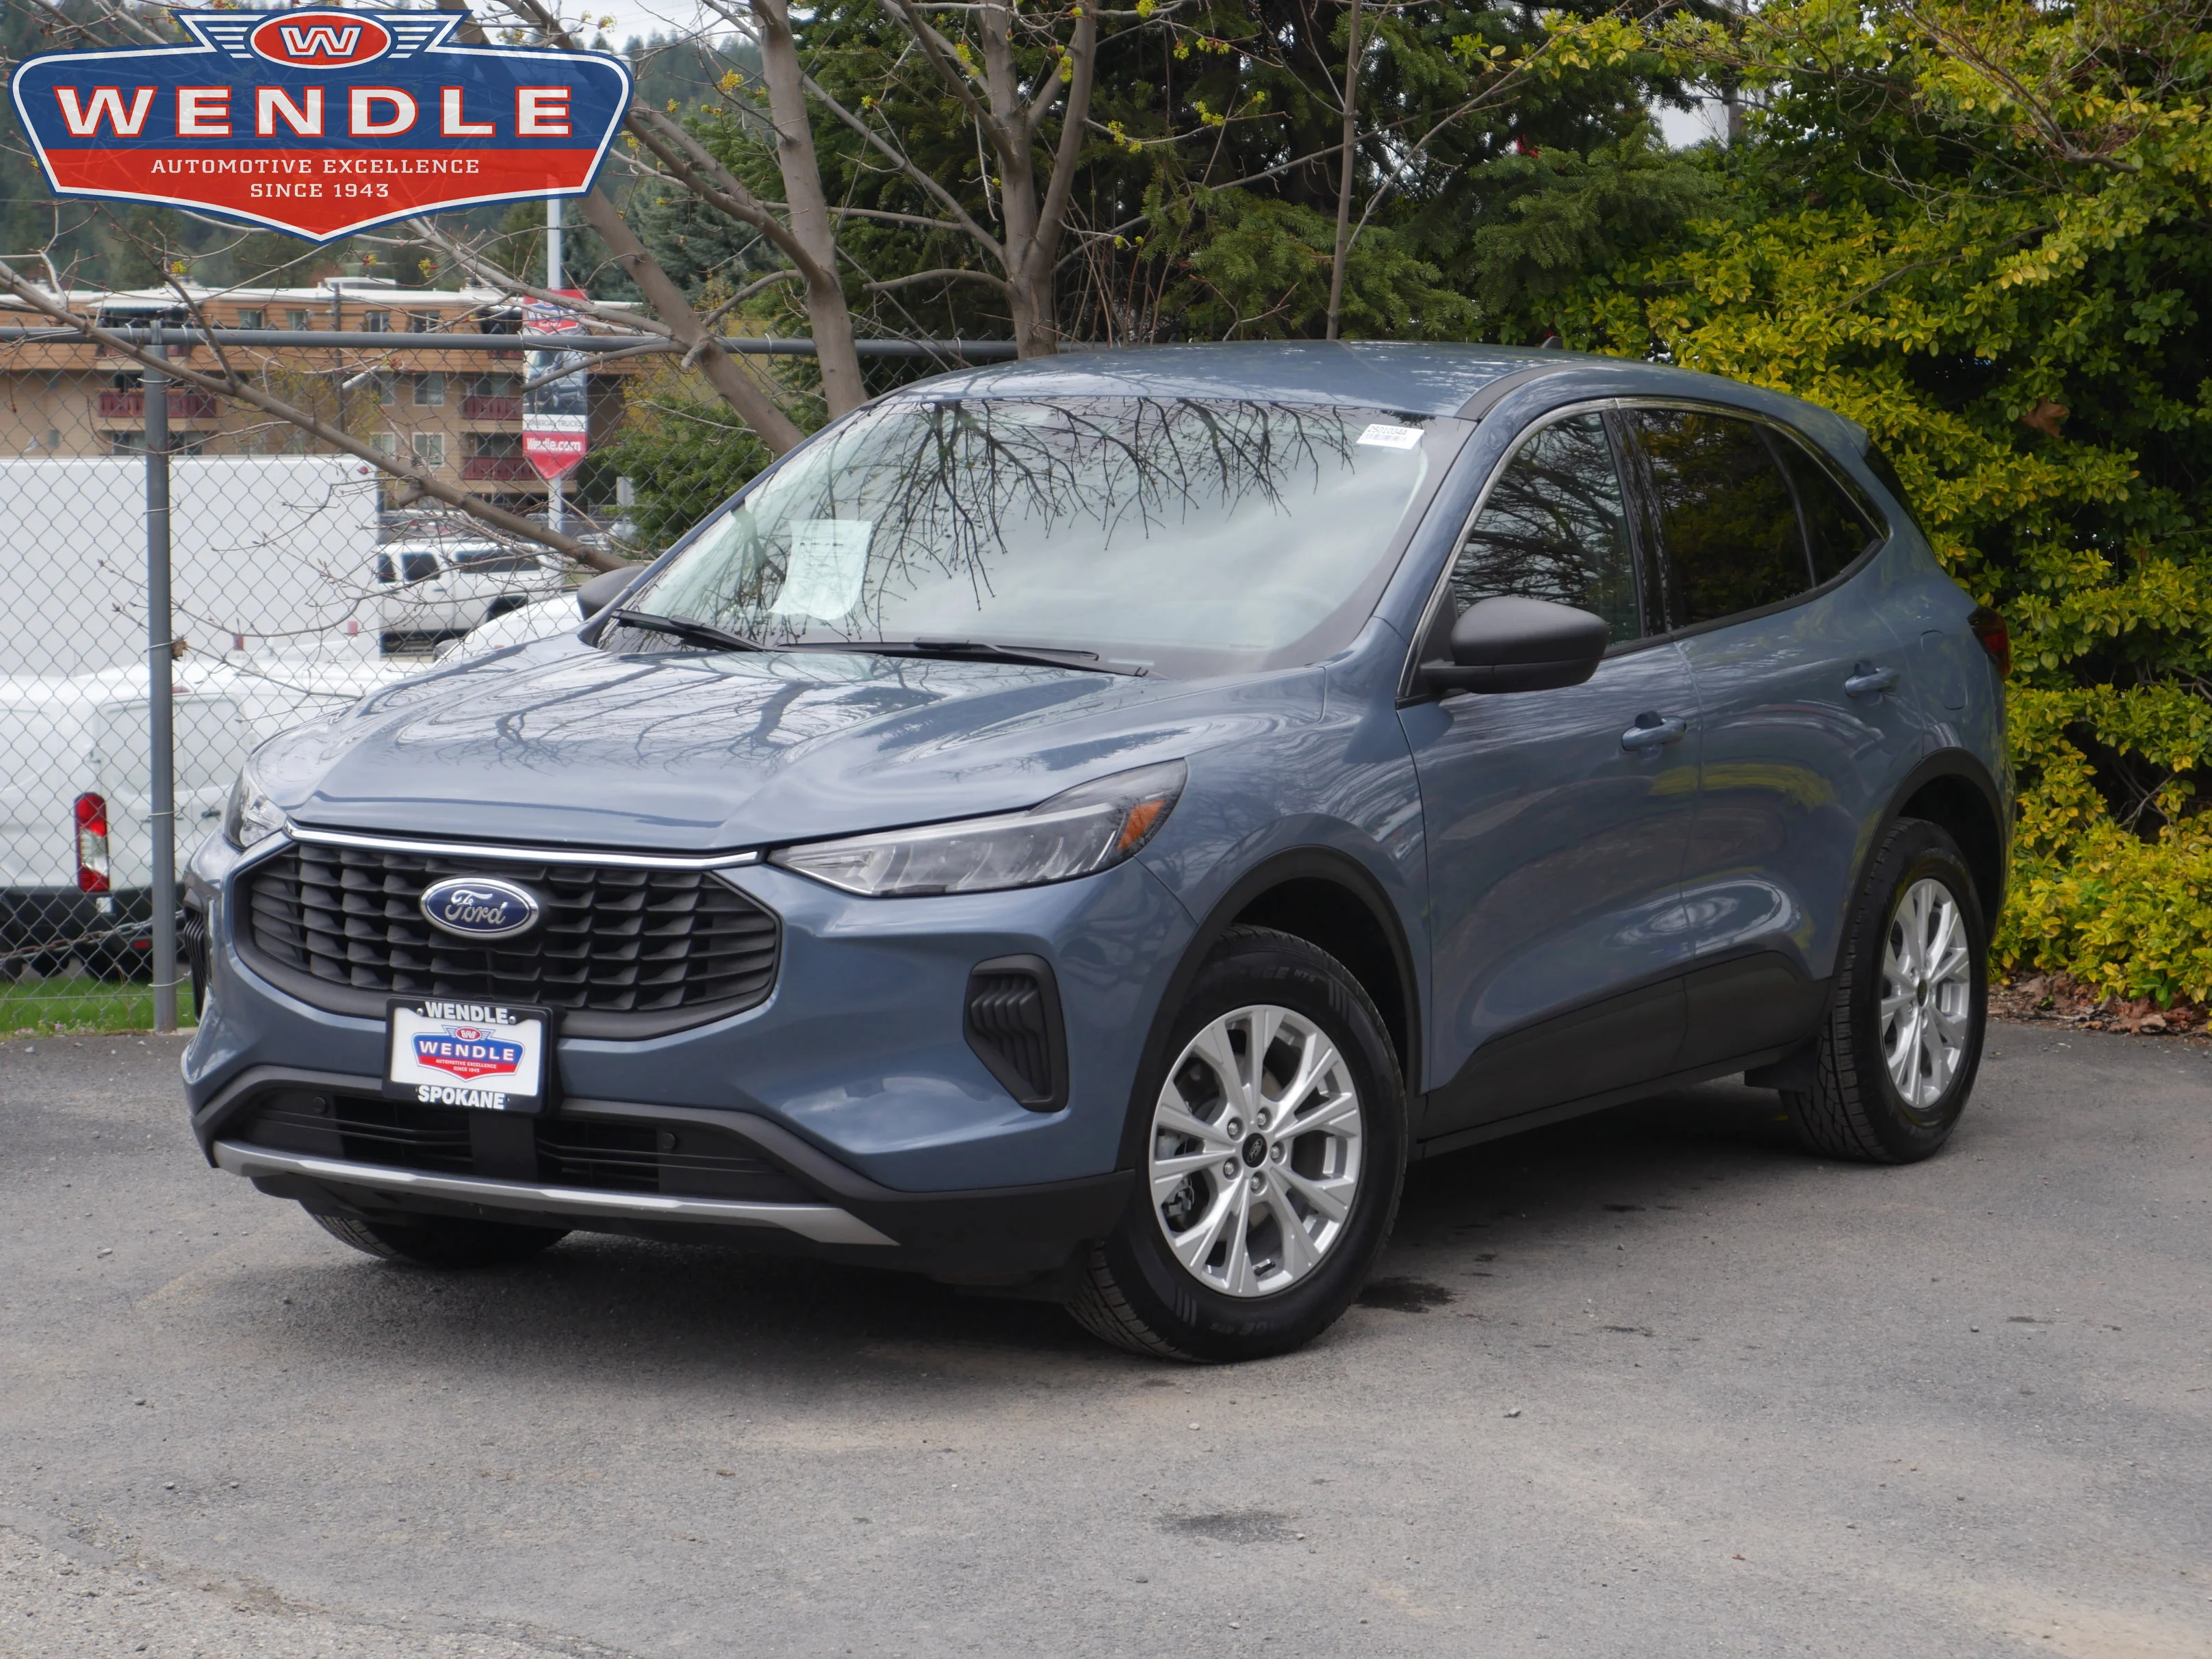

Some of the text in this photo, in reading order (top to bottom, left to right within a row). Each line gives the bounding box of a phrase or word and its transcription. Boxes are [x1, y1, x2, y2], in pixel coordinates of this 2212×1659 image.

[444, 889, 509, 924] Ford
[424, 1001, 509, 1025] WENDLE
[419, 1040, 514, 1061] WENDLE
[417, 1085, 505, 1109] SPOKANE
